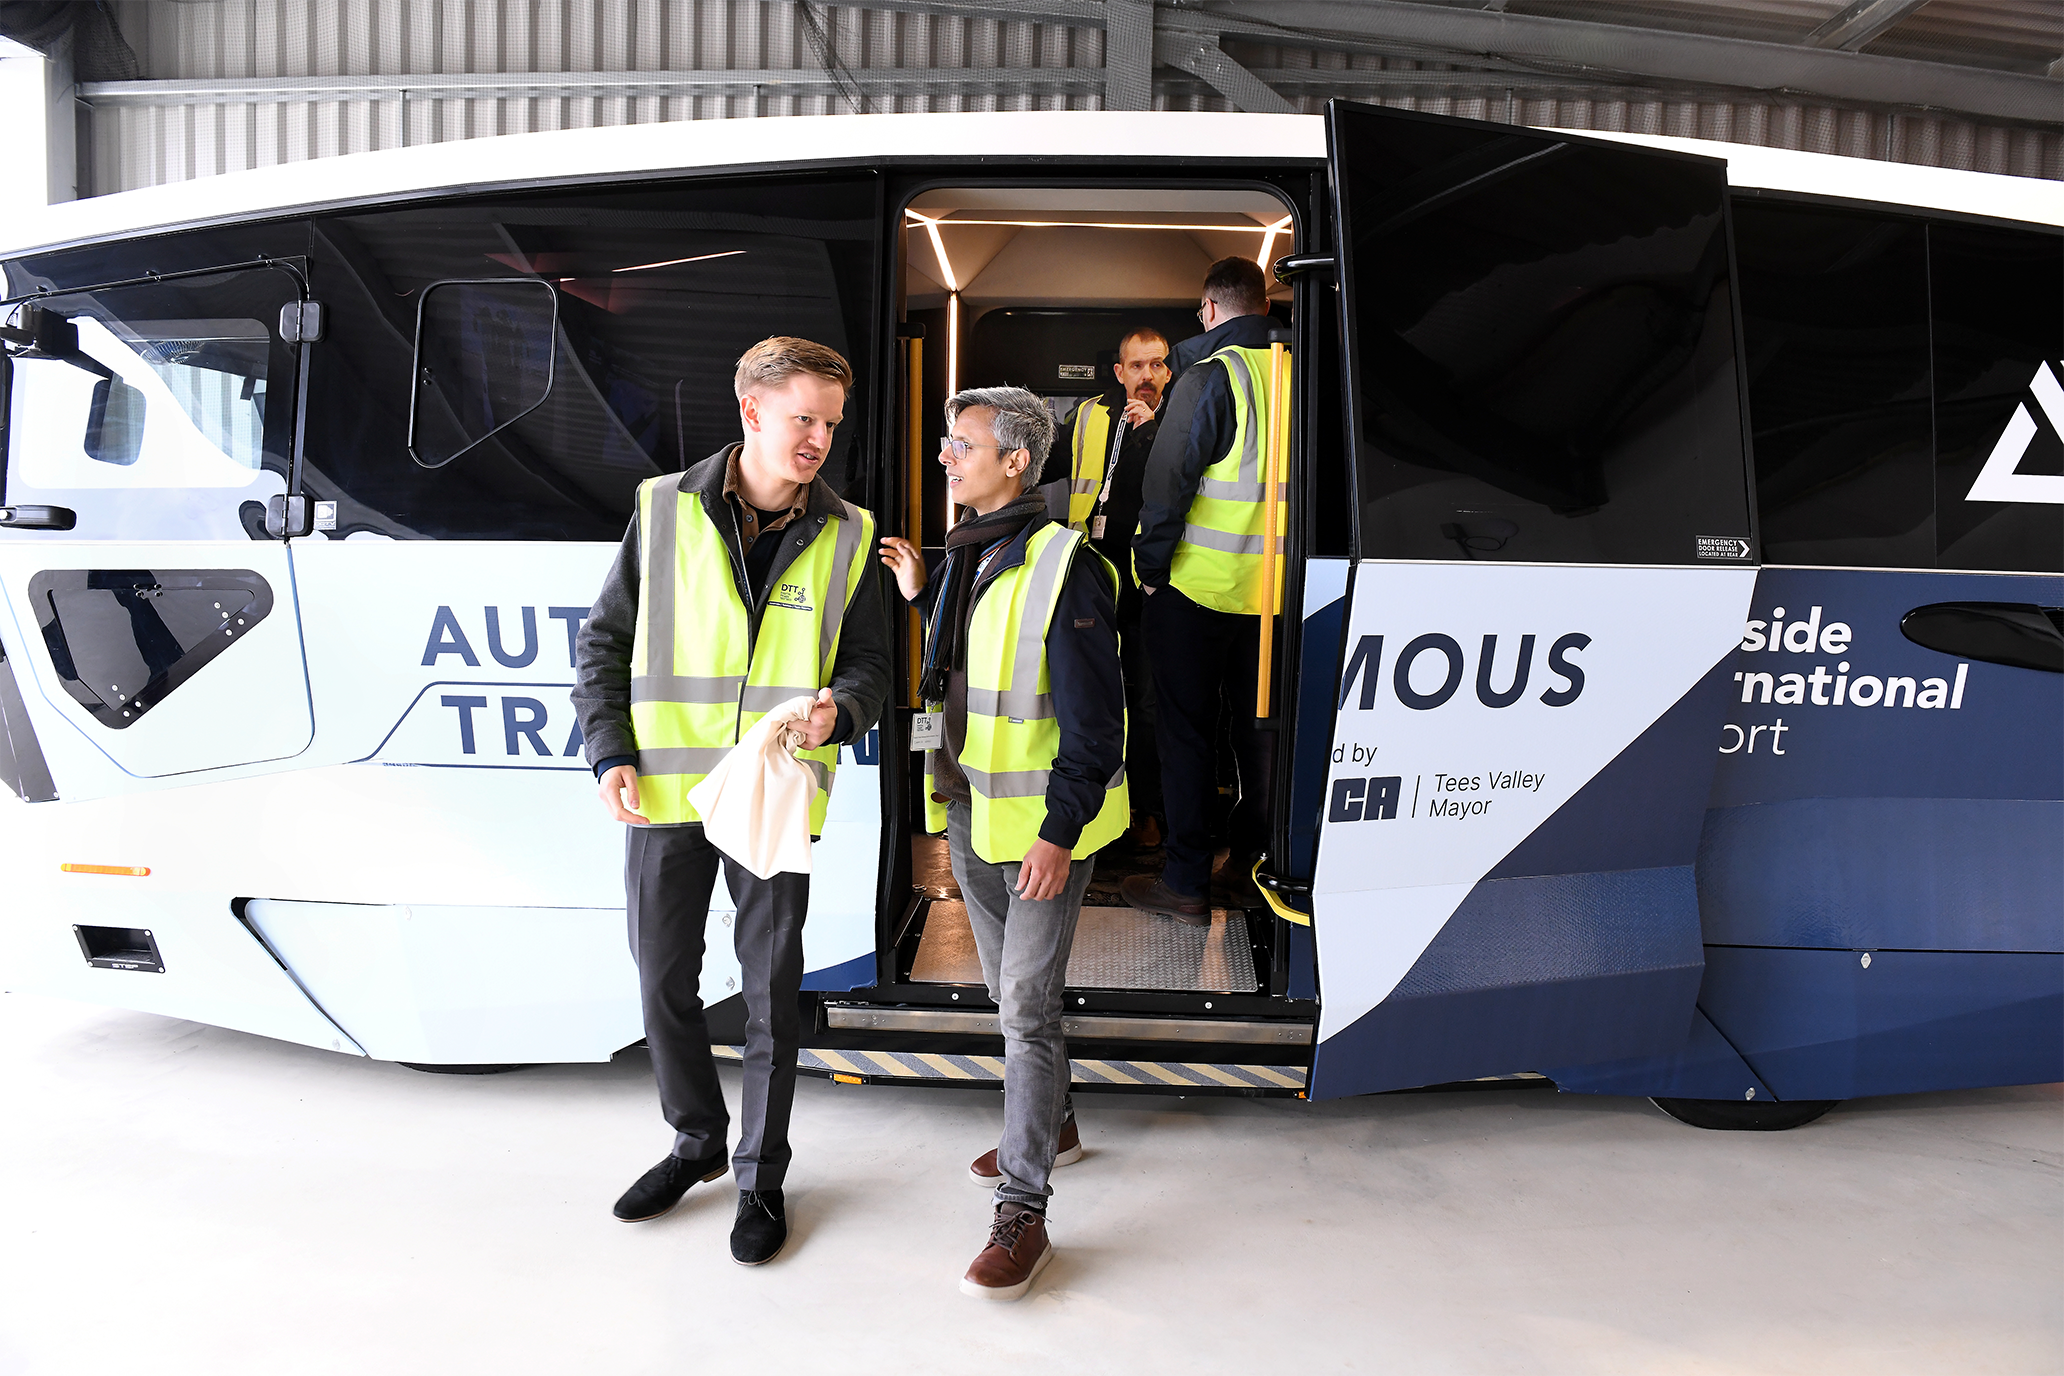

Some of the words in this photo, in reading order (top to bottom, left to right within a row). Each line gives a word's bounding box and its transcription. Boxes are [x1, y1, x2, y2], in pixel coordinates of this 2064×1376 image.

[1698, 538, 1738, 547] EMERGENCY
[1716, 545, 1738, 553] RELEASE
[781, 583, 799, 593] DTT
[1741, 605, 1853, 655] side
[1734, 660, 1970, 710] national
[917, 717, 928, 725] DTT
[1352, 742, 1378, 767] by
[1328, 776, 1402, 823] CA
[1434, 773, 1481, 793] Tees
[1488, 769, 1546, 793] Valley
[1428, 798, 1493, 821] Mayor
